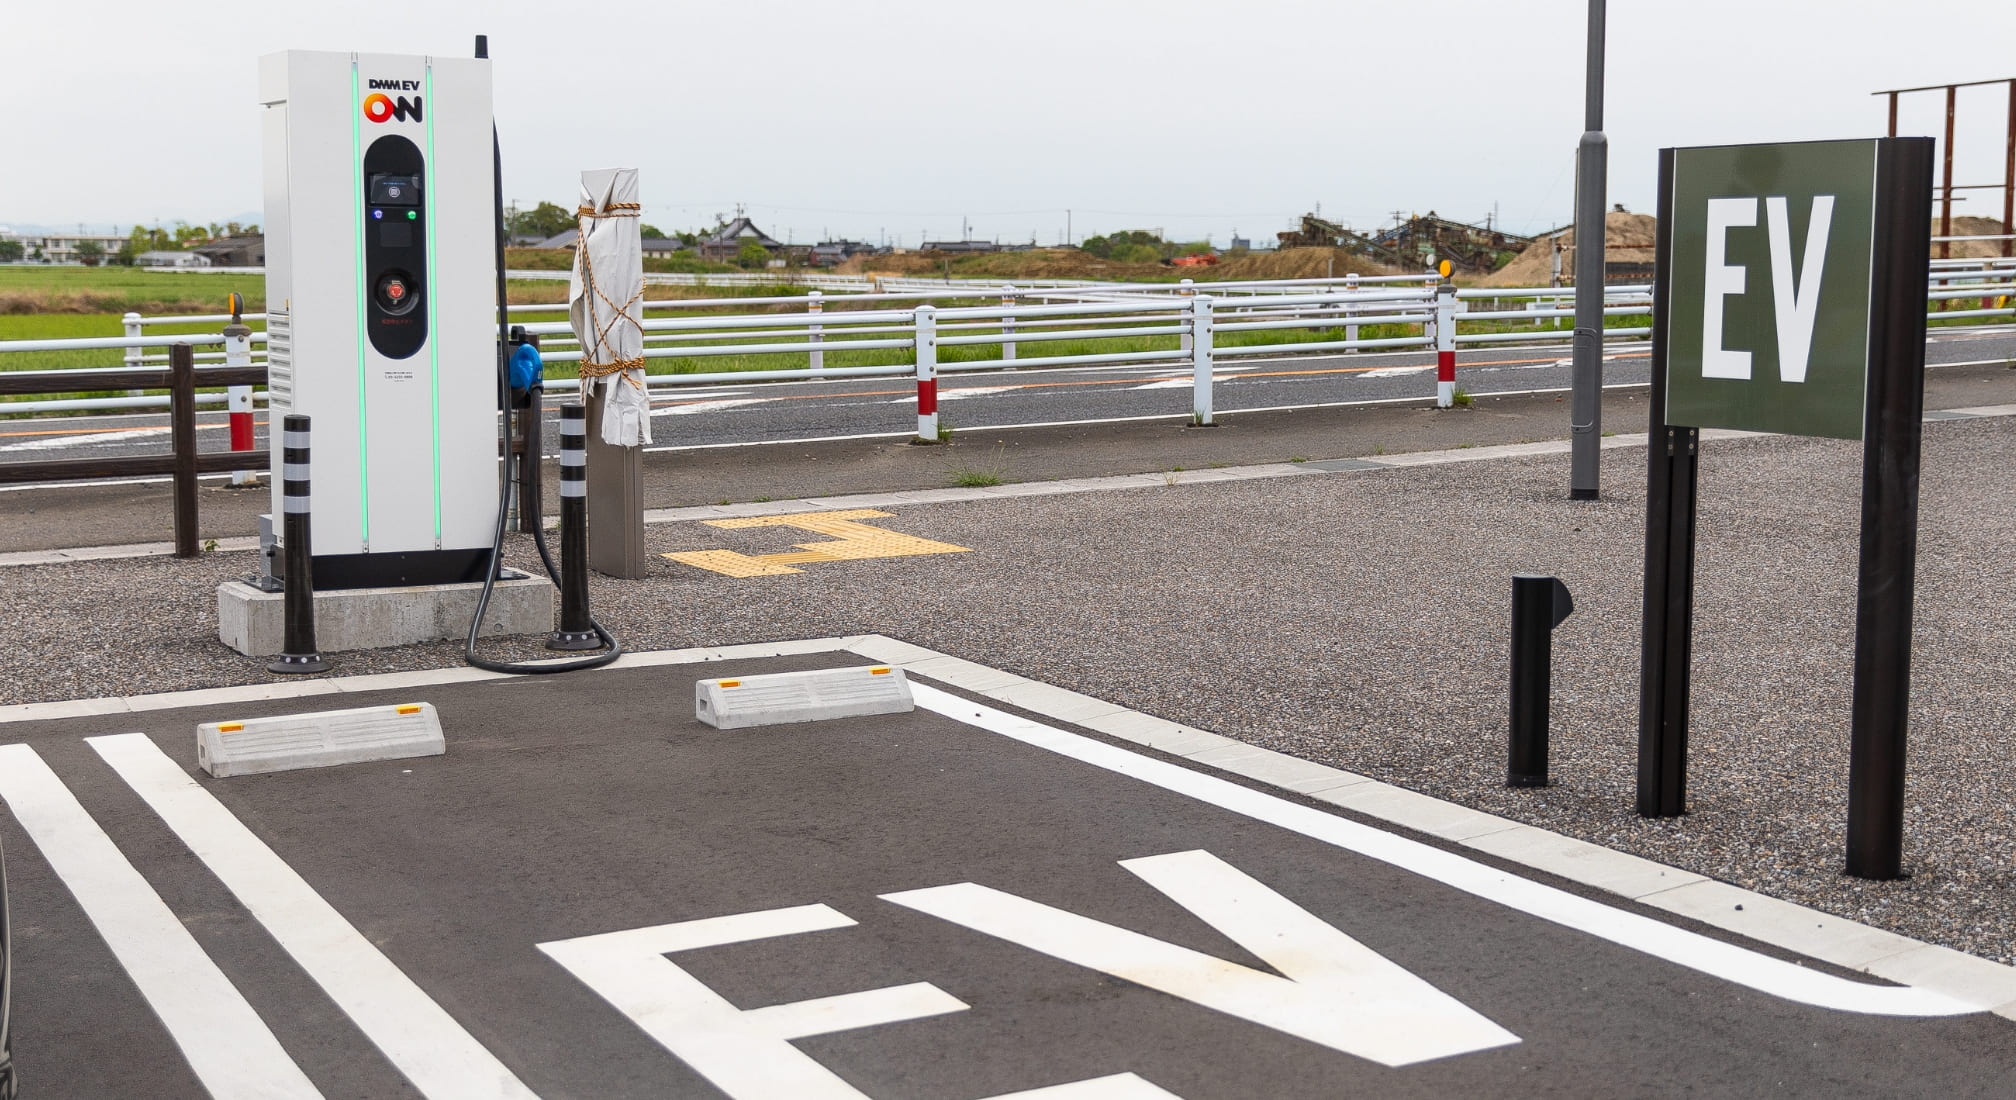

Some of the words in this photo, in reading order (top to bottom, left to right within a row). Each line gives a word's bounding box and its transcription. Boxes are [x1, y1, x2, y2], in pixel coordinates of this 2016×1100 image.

[363, 92, 423, 124] ON
[368, 78, 401, 91] DMM
[402, 80, 420, 91] EV
[1701, 194, 1836, 384] EV
[536, 849, 1523, 1100] EV
